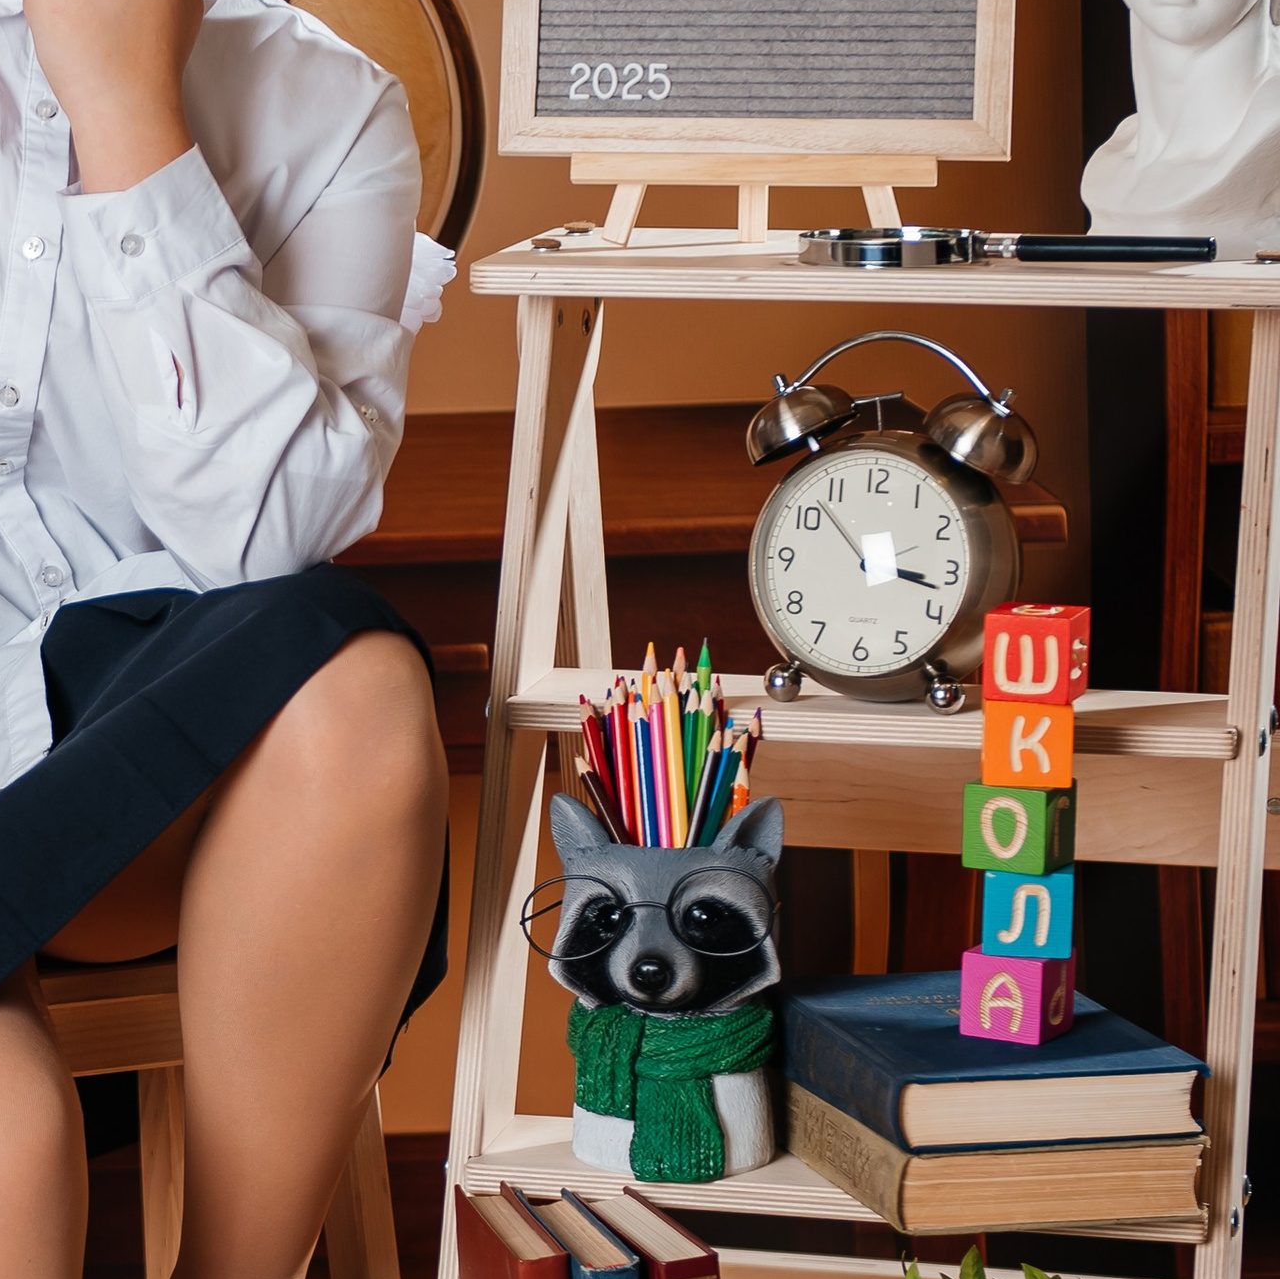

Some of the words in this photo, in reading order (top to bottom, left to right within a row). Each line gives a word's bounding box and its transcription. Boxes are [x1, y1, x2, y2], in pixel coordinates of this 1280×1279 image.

[568, 62, 673, 101] 2025
[828, 477, 844, 503] 11
[867, 468, 890, 494] 12
[914, 484, 920, 509] 1
[796, 505, 821, 531] 10
[935, 515, 951, 540] 2
[778, 547, 795, 572] 9
[944, 560, 960, 586] 3
[786, 590, 803, 614] 8
[926, 599, 943, 625] 4
[811, 620, 826, 644] 7
[848, 616, 878, 625] QUARTZ
[852, 636, 869, 662] 6
[893, 630, 908, 655] 5
